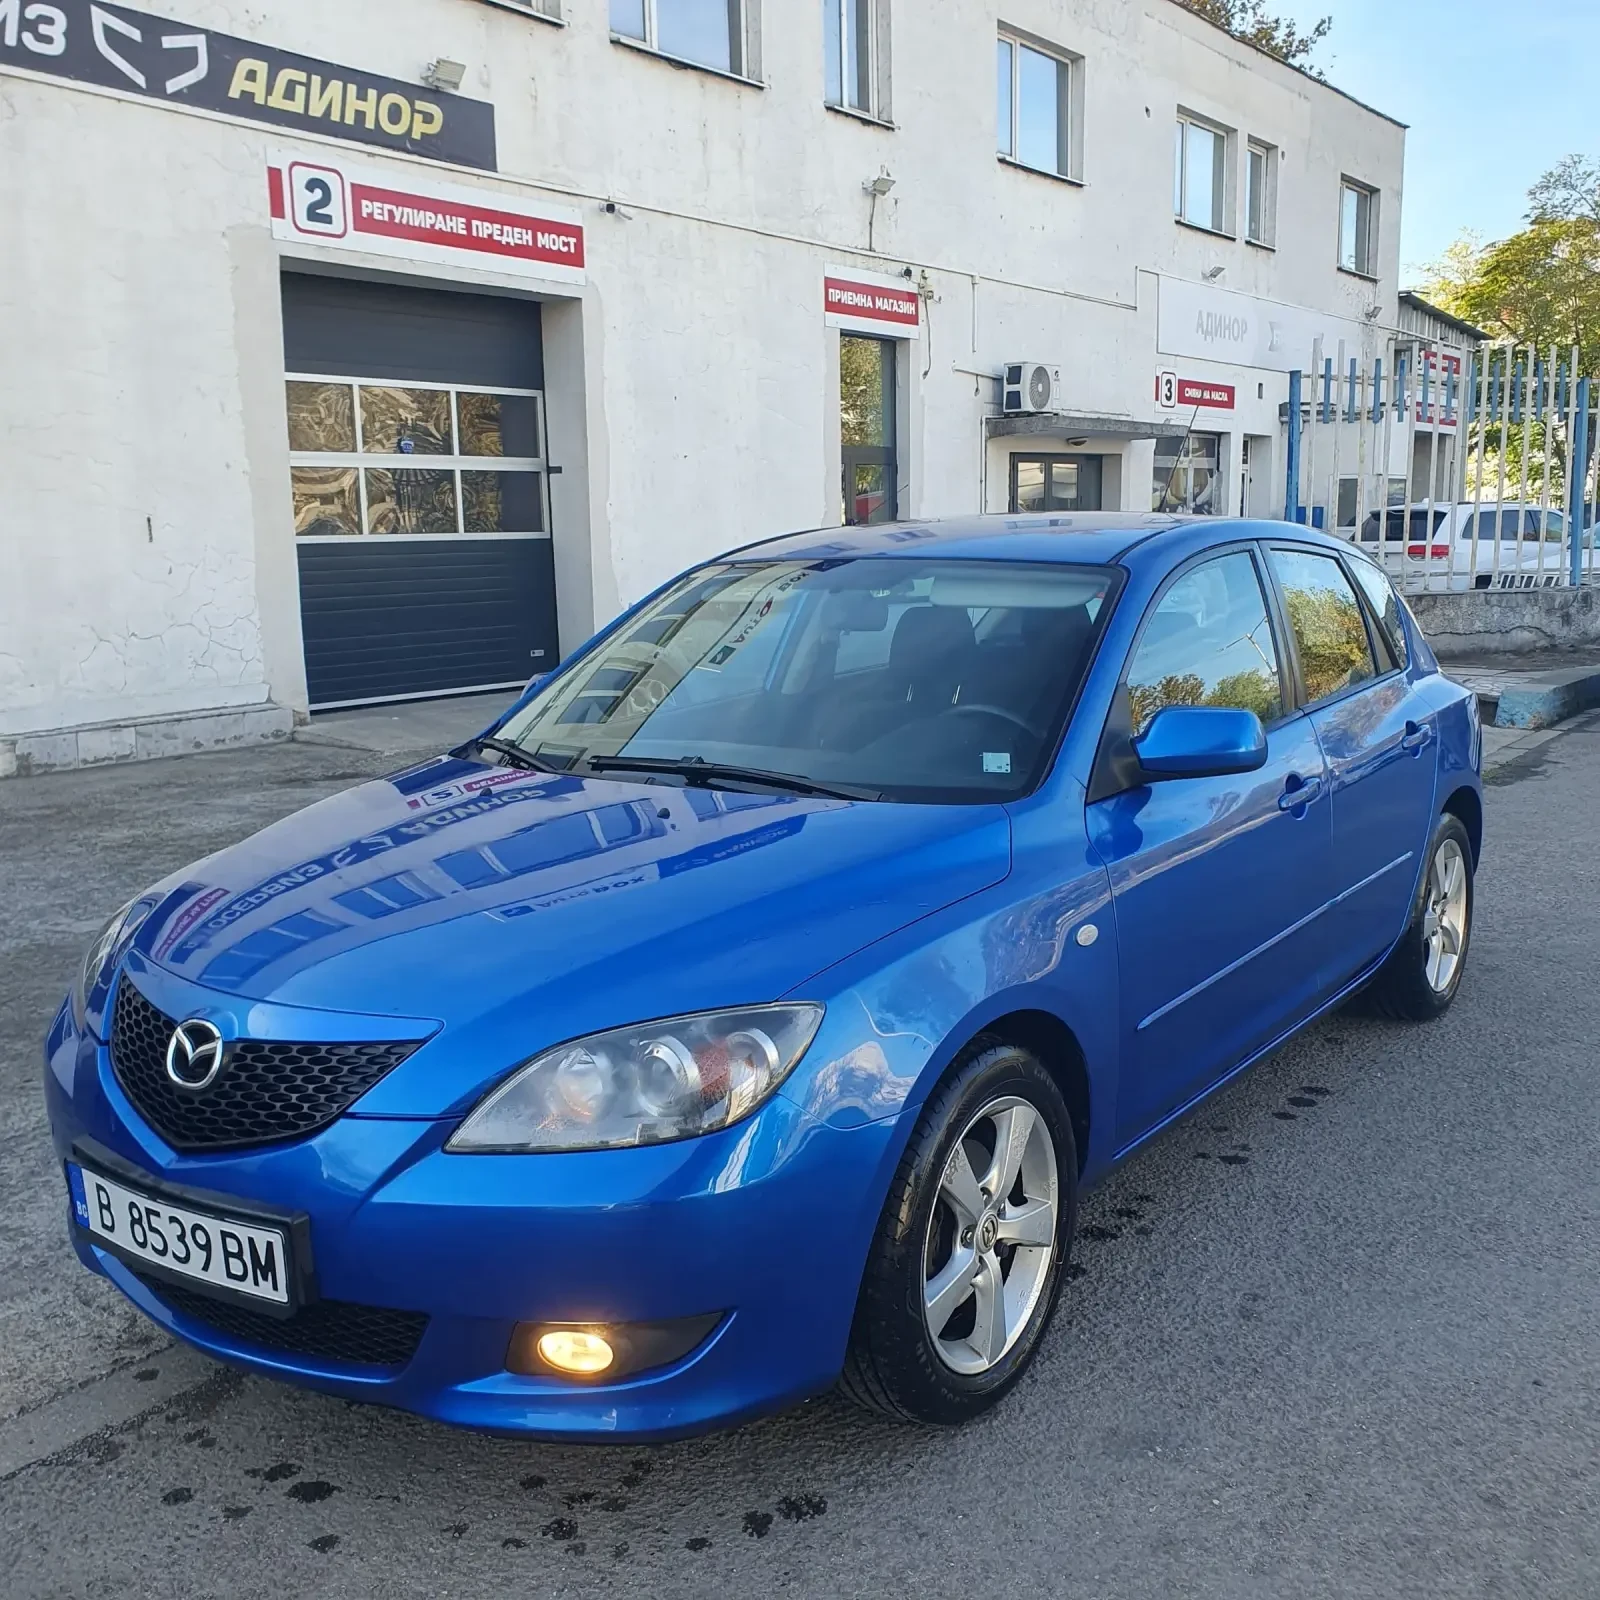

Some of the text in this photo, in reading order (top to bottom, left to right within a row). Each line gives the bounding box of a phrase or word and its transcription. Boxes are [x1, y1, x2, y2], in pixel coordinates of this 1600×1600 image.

[227, 57, 444, 141] АДИНОР
[303, 176, 334, 226] 2
[361, 199, 577, 254] РЕГУЛИРАНЕ ПРЕДЕН МОСТ
[828, 288, 916, 315] ПРИЕМНА МАГАЗИН
[1195, 309, 1248, 344] АДИНОР
[1164, 378, 1173, 402] 3
[76, 1200, 89, 1220] BG
[95, 1181, 279, 1293] B 8539 BM
